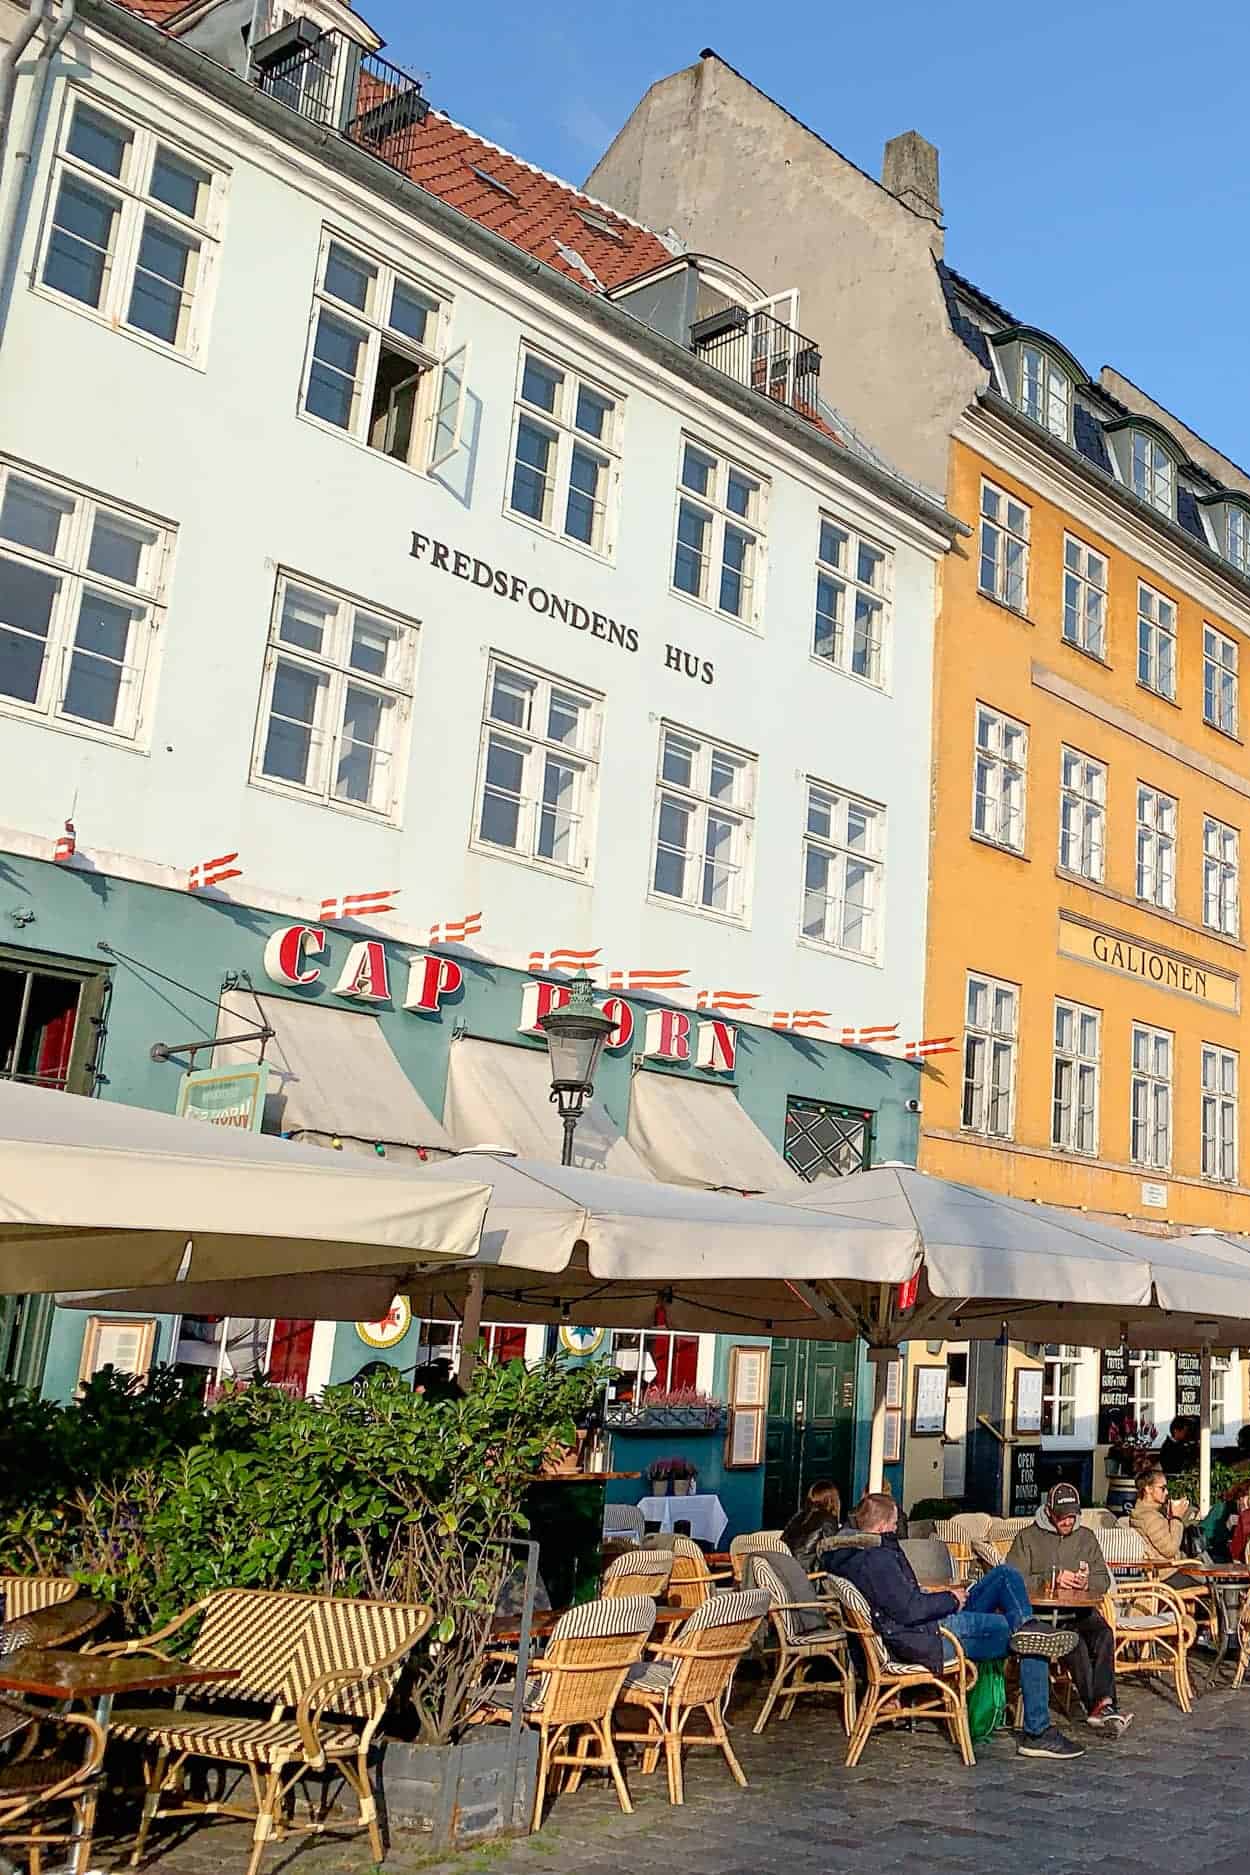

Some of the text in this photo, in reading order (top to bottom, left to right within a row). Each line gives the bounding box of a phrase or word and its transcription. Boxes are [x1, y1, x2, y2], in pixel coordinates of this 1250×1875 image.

[408, 530, 715, 686] FREDSFONDENS HUS
[264, 924, 463, 1013] CAP
[1092, 935, 1208, 997] GALIONEN
[1017, 1452, 1035, 1468] OPEN
[1021, 1468, 1035, 1483] FOR
[1015, 1484, 1038, 1499] DINNER
